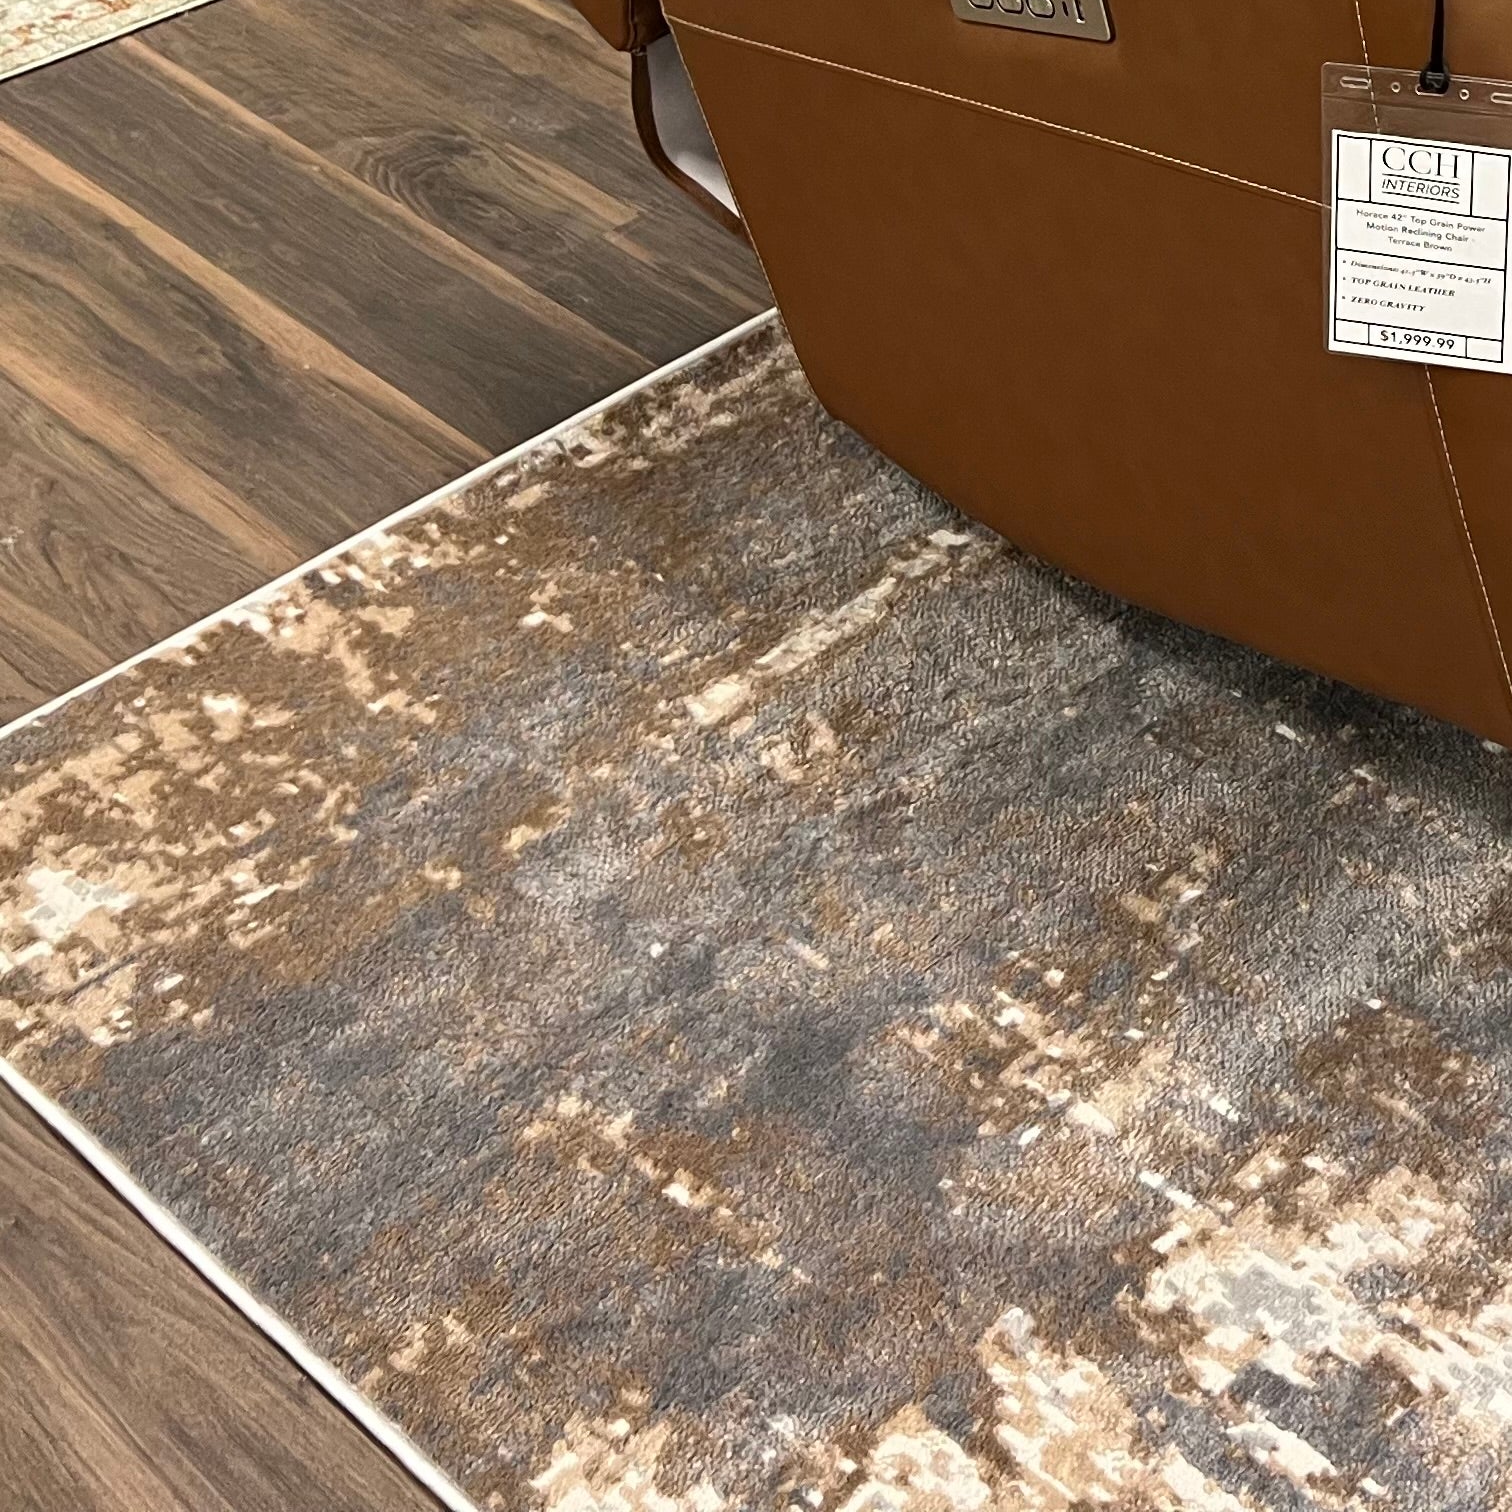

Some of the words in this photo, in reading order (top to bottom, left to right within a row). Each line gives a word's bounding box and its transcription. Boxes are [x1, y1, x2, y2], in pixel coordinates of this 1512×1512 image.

[1382, 146, 1460, 179] CCH
[1381, 178, 1460, 199] INTERIORS
[1356, 209, 1388, 219] Horace
[1410, 215, 1427, 225] Top
[1429, 218, 1454, 229] Grain
[1457, 222, 1485, 232] Power
[1366, 221, 1399, 233] Motion
[1401, 225, 1442, 240] Reclining
[1445, 232, 1469, 242] Chair
[1388, 235, 1421, 247] Terrace
[1423, 241, 1452, 251] Brown
[1351, 276, 1371, 285] TOP
[1373, 279, 1406, 290] GRAIN
[1408, 284, 1455, 296] LEATHER
[1351, 296, 1378, 305] ZERO
[1379, 299, 1426, 311] GRAVITY
[1380, 329, 1455, 349] $1,999.99
